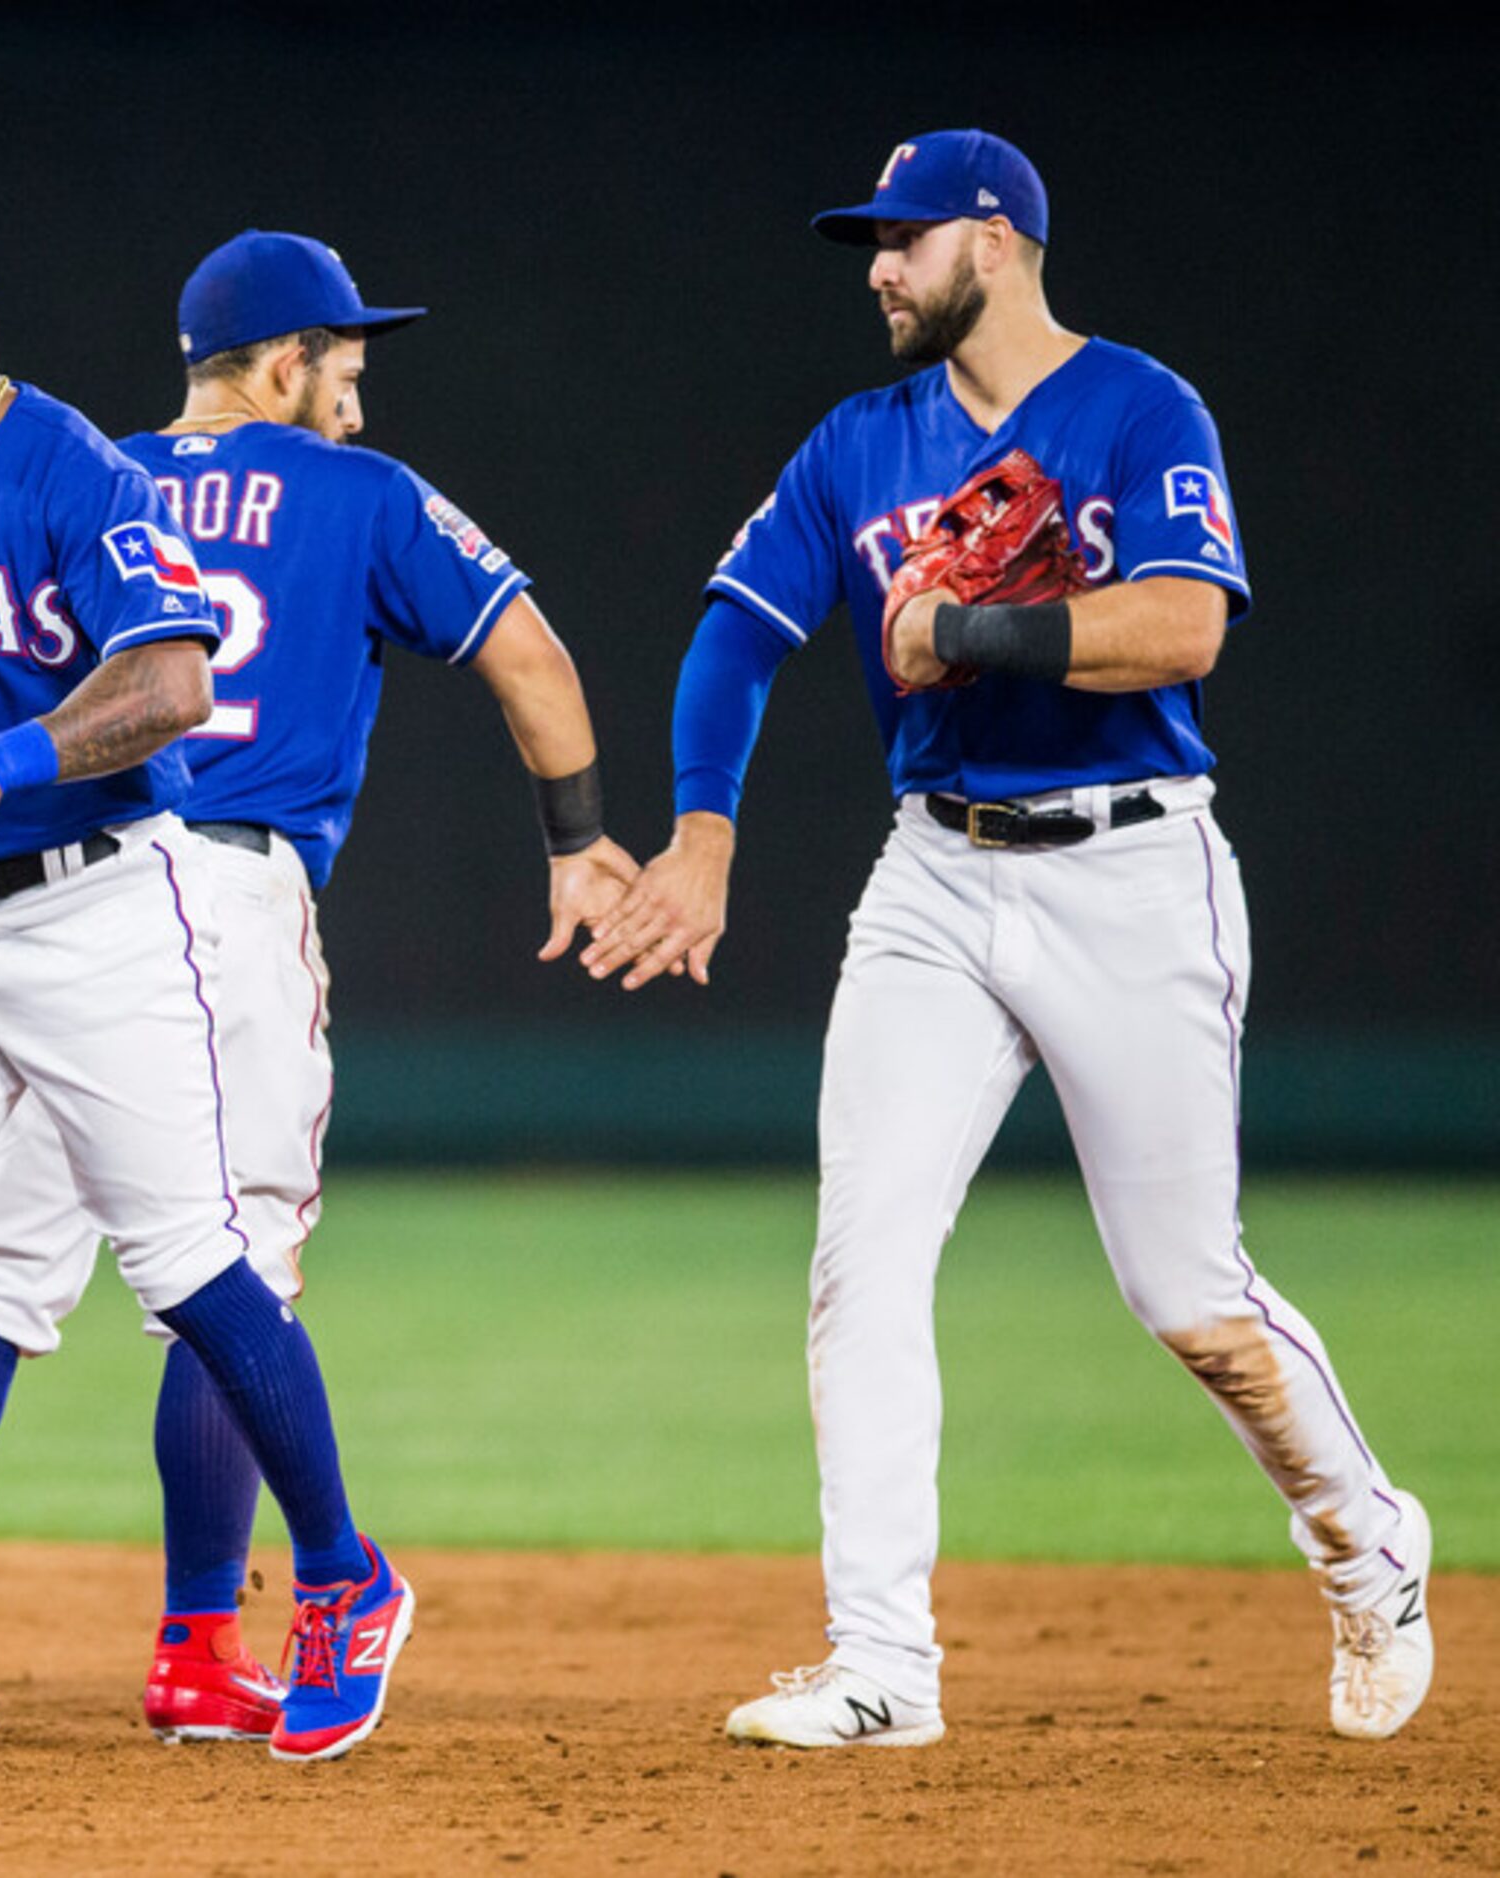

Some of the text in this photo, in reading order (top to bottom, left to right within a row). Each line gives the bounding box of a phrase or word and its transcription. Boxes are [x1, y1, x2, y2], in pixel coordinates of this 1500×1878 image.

[876, 142, 917, 190] T
[154, 469, 284, 548] DOR
[843, 1694, 892, 1735] N
